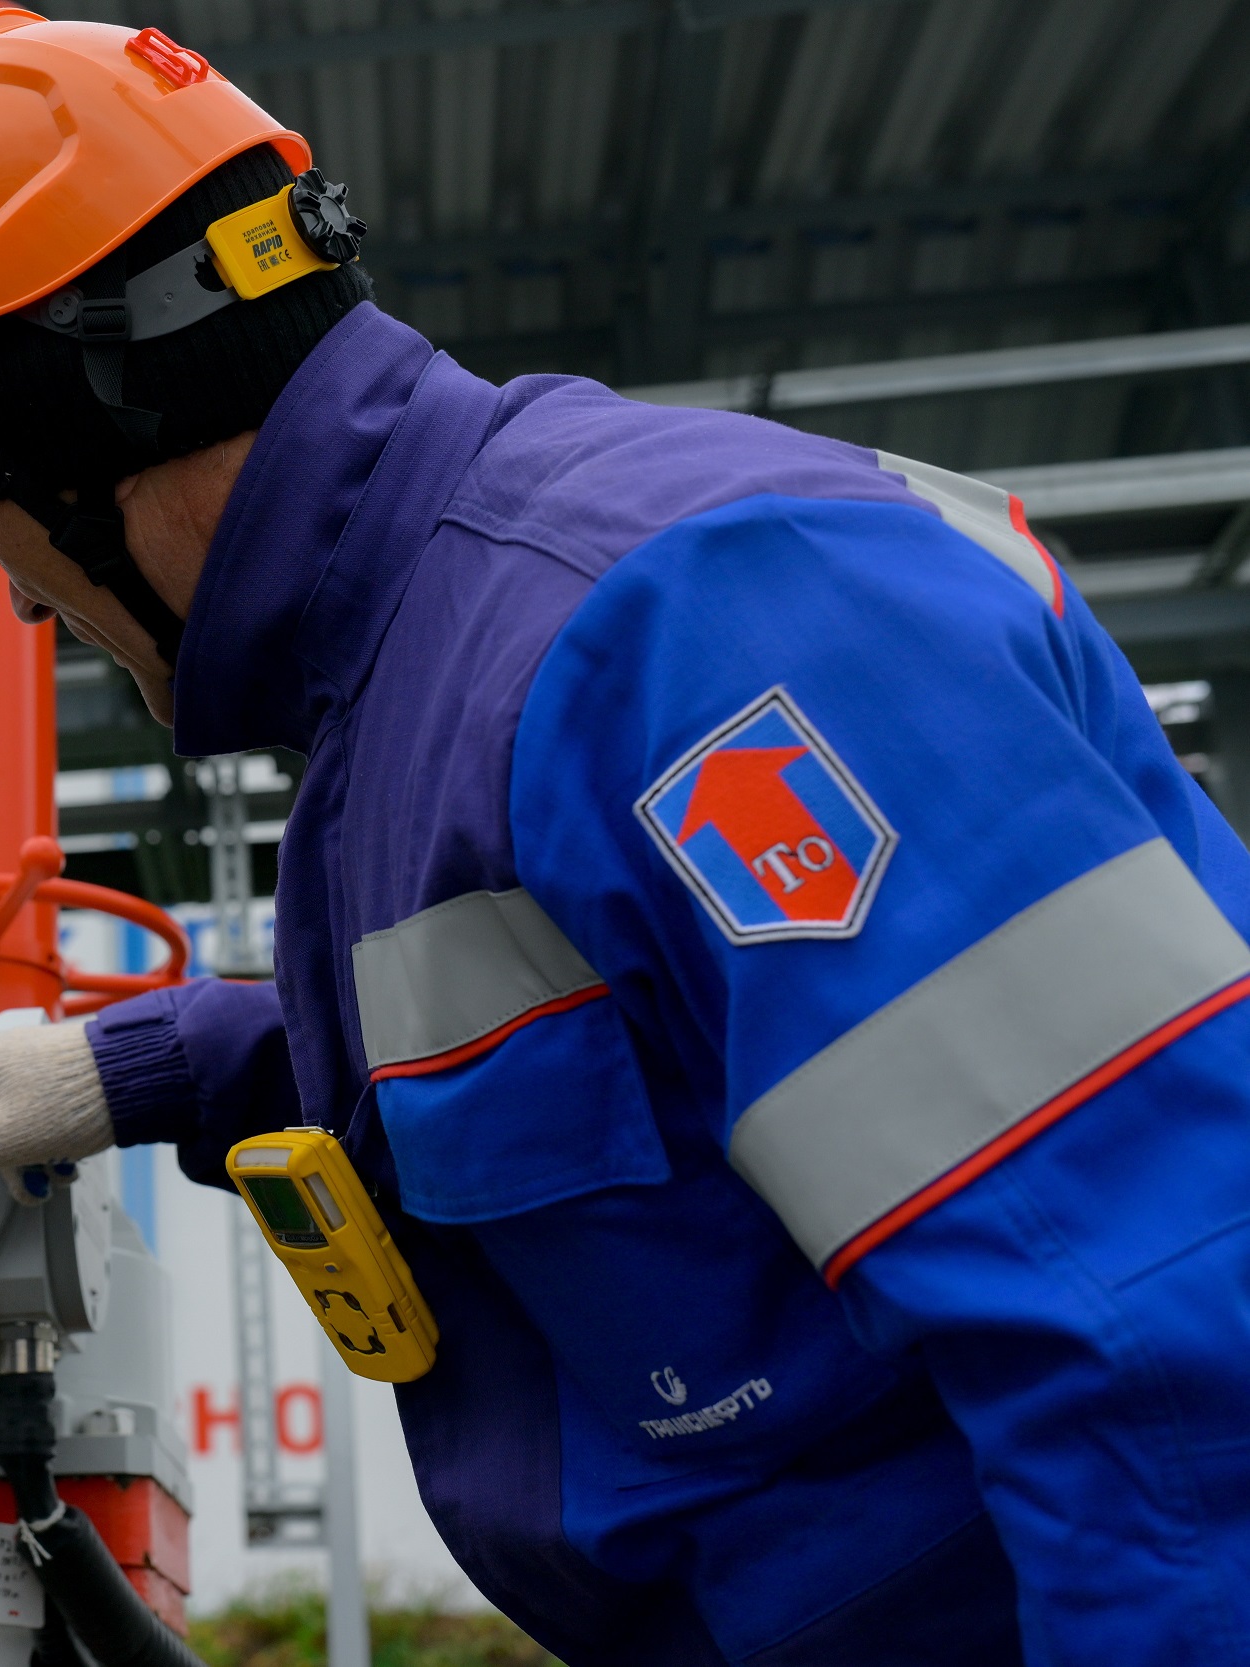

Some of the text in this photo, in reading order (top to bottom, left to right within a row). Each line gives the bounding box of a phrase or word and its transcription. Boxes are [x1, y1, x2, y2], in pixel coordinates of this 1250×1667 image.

[242, 219, 274, 238] храповой
[245, 226, 277, 244] механизм
[252, 234, 283, 258] RAPID
